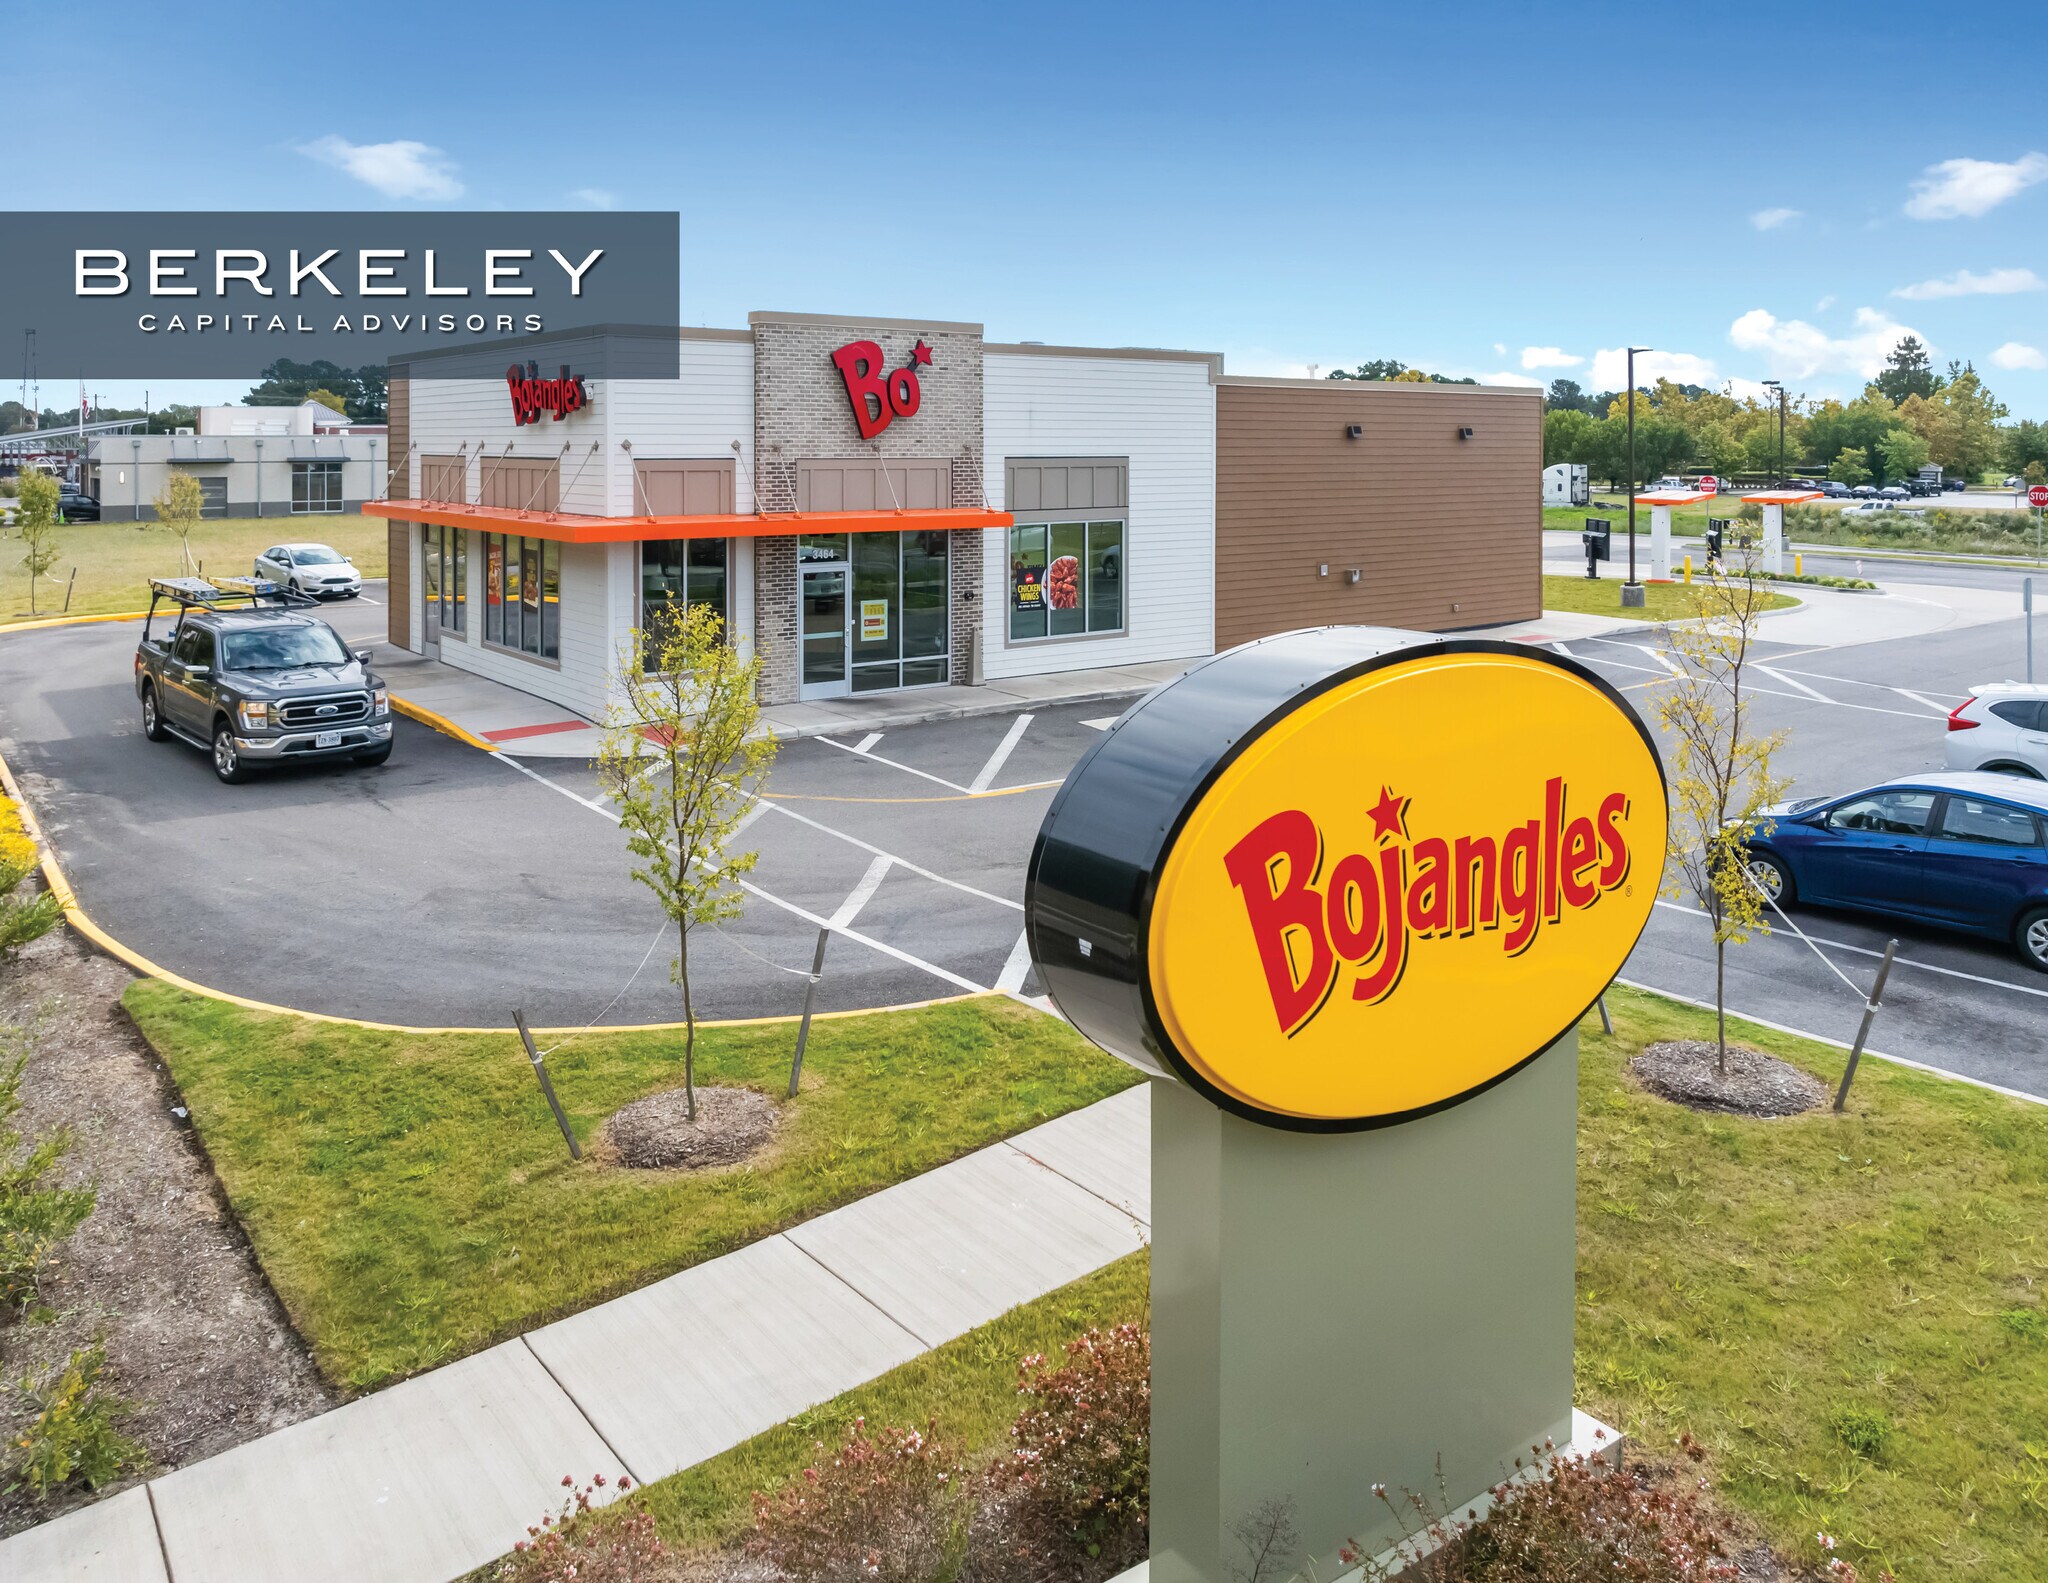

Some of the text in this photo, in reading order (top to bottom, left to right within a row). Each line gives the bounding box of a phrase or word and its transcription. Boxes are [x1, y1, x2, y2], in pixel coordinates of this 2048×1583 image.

[506, 363, 587, 427] Bojangles
[830, 340, 921, 440] Bo
[812, 549, 834, 560] 3464
[1017, 584, 1041, 593] CHICKEN
[1020, 592, 1040, 601] WINGS
[1223, 776, 1632, 1040] Bojangles
